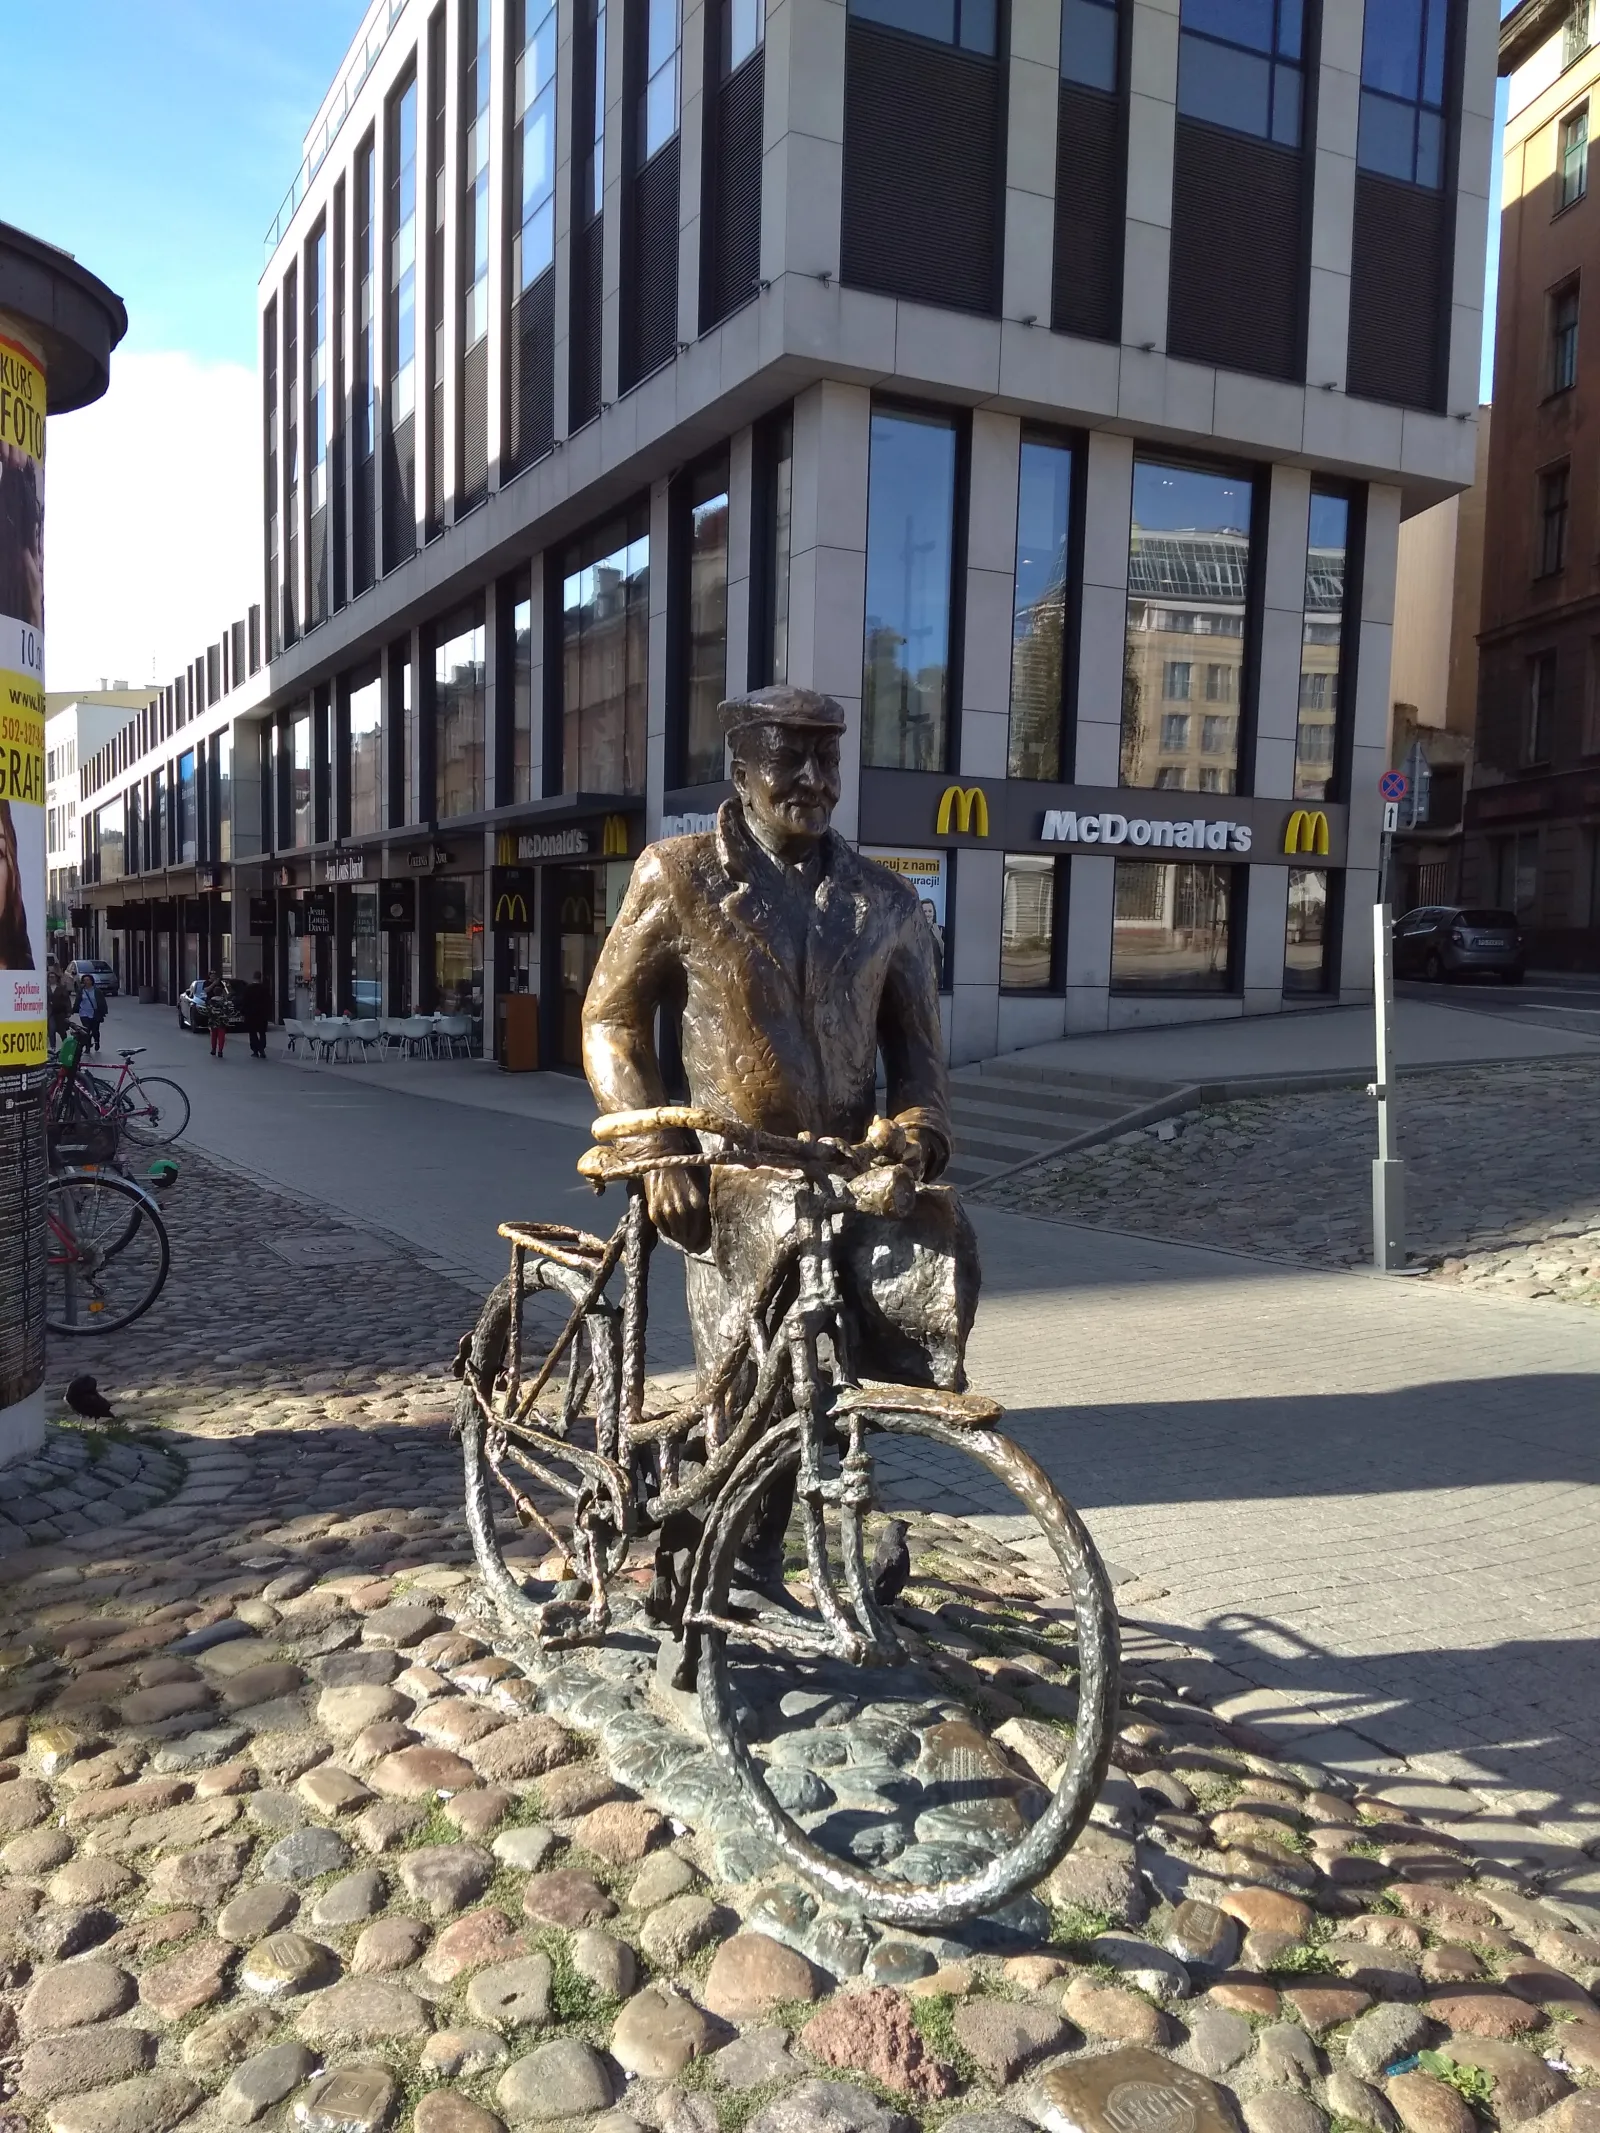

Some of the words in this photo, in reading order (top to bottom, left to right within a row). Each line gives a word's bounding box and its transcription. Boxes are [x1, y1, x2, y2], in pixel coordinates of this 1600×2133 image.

[0, 352, 33, 402] KURS
[1041, 809, 1252, 852] McDonald's
[518, 829, 588, 859] McDonald's
[874, 857, 900, 872] acuj
[902, 861, 909, 870] z
[911, 859, 940, 872] nami
[907, 876, 940, 888] uracji!
[307, 906, 326, 916] Jean
[308, 915, 329, 924] Louis
[308, 923, 330, 932] David
[14, 980, 40, 999] Spotkanie
[0, 1031, 45, 1054] SFOTO.PL
